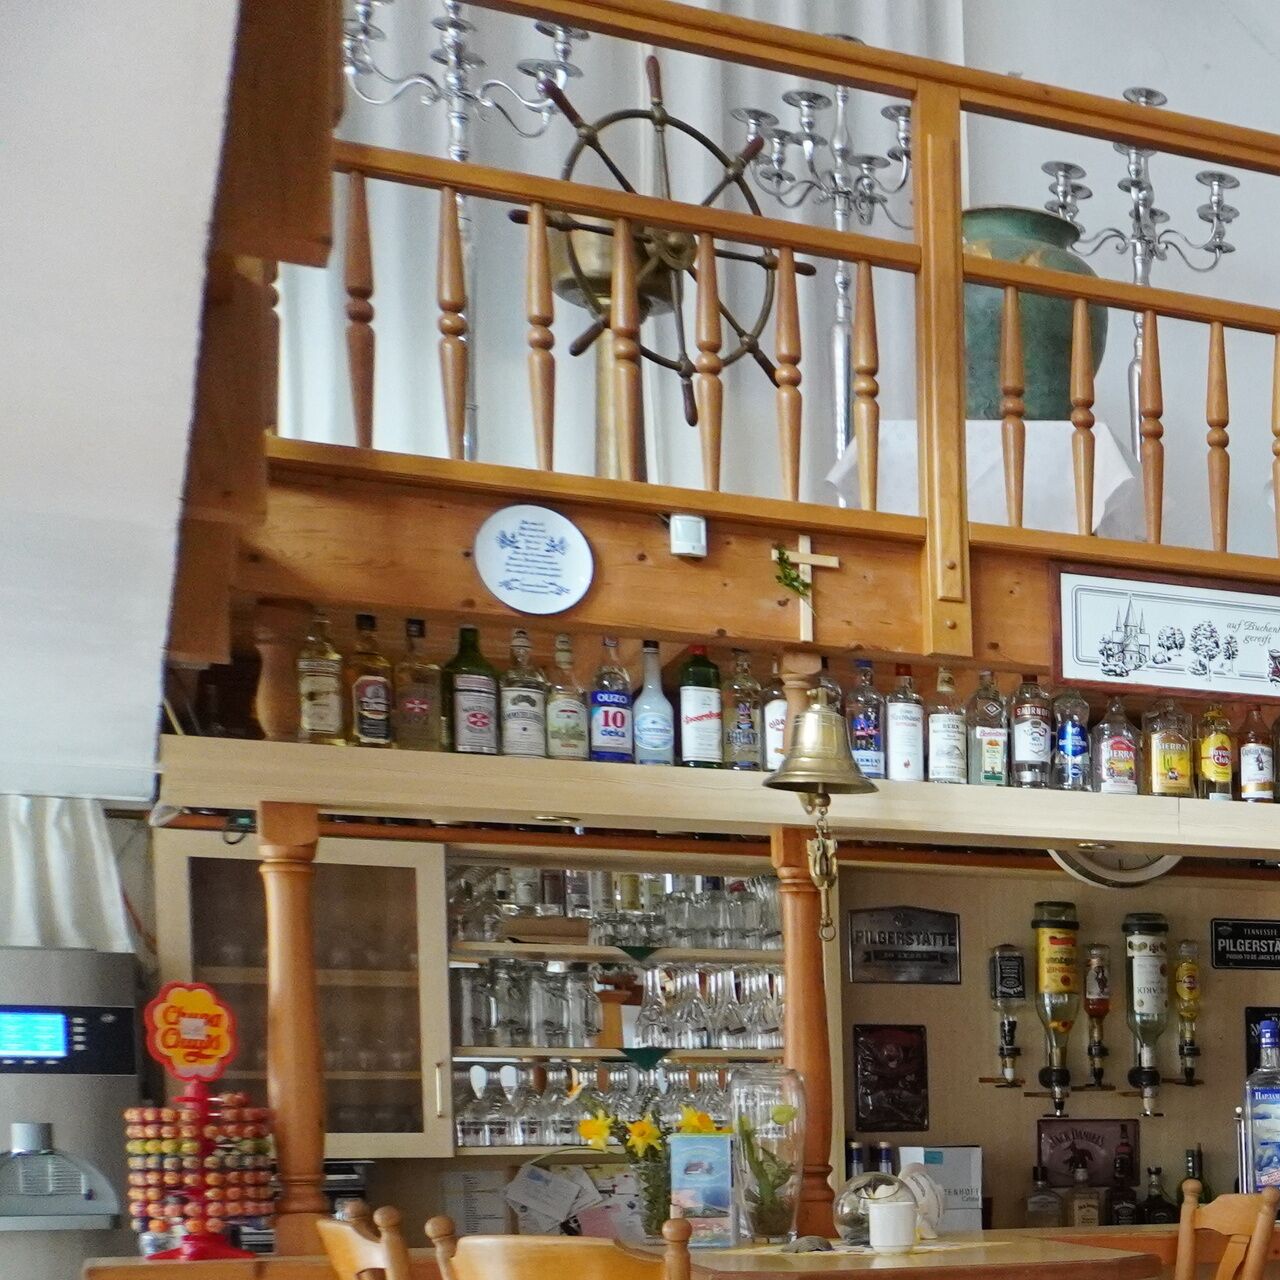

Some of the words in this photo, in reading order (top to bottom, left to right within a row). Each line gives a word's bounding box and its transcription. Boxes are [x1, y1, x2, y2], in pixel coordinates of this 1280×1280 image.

[1226, 620, 1242, 632] auf
[1243, 633, 1271, 646] gereift
[597, 693, 627, 704] OUZO
[602, 710, 625, 728] 10
[601, 729, 626, 738] deka
[1244, 928, 1277, 936] TENNESSEE
